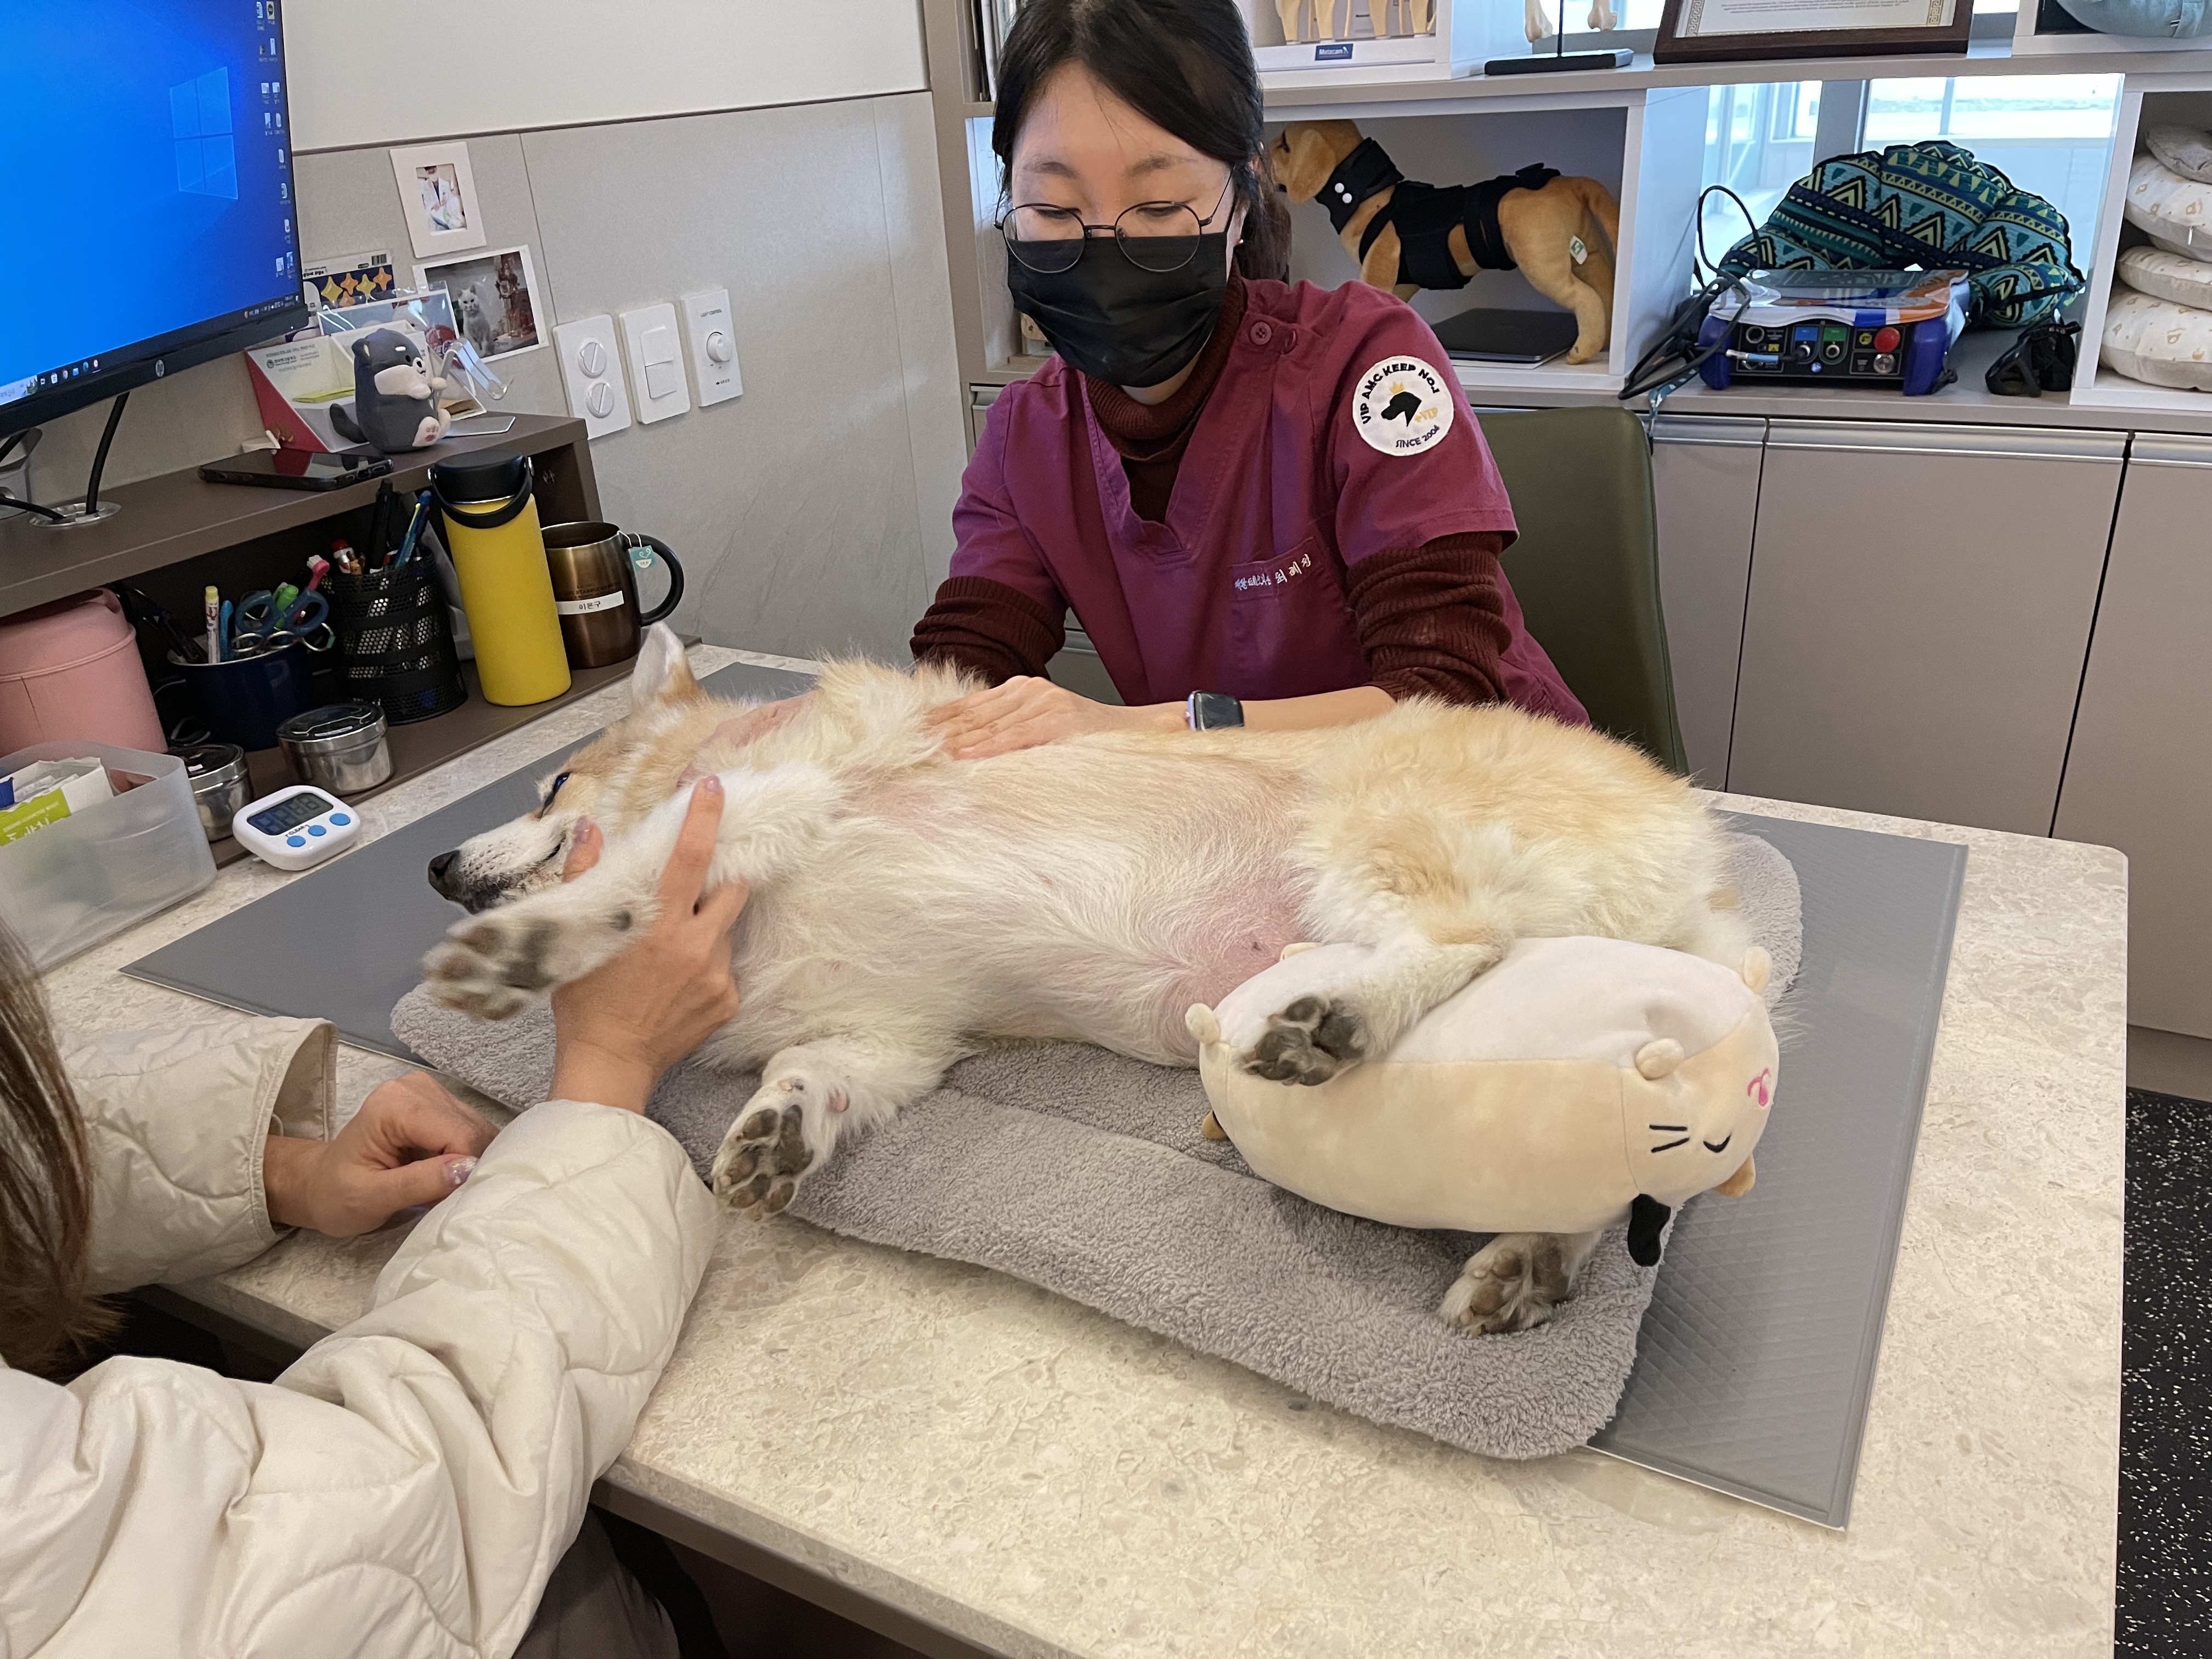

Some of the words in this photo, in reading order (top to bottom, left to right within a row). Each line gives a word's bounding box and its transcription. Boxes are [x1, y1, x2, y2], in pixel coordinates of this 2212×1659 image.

[1382, 363, 1416, 376] KEEP
[1362, 373, 1383, 399] AMC
[1360, 403, 1372, 424] VIP
[1395, 437, 1422, 448] SINCE
[1422, 425, 1440, 441] 2004
